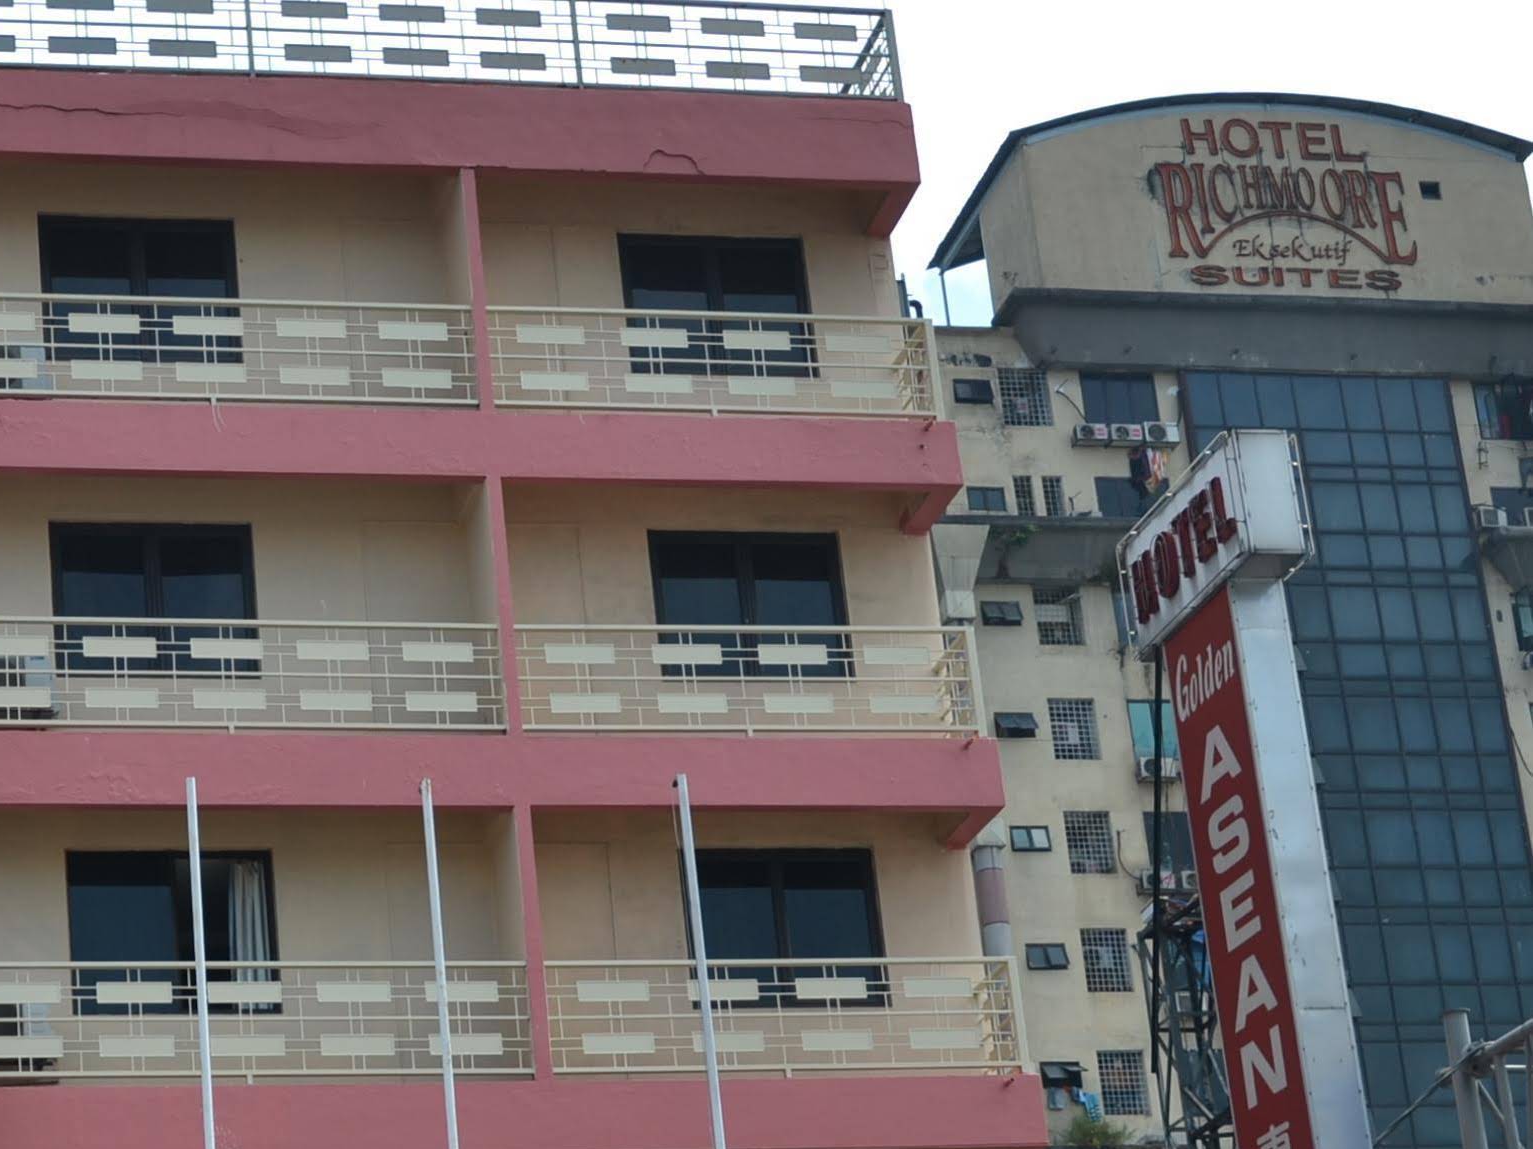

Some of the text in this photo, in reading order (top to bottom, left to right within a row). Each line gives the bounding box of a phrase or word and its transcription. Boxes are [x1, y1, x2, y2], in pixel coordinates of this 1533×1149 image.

[1179, 117, 1366, 163] HOTEL
[1153, 162, 1418, 266] RICHMOORE
[1189, 264, 1403, 291] SUITES
[1131, 476, 1239, 625] HOTEL
[1175, 640, 1236, 723] Golden
[1200, 724, 1289, 1111] ASEAN
